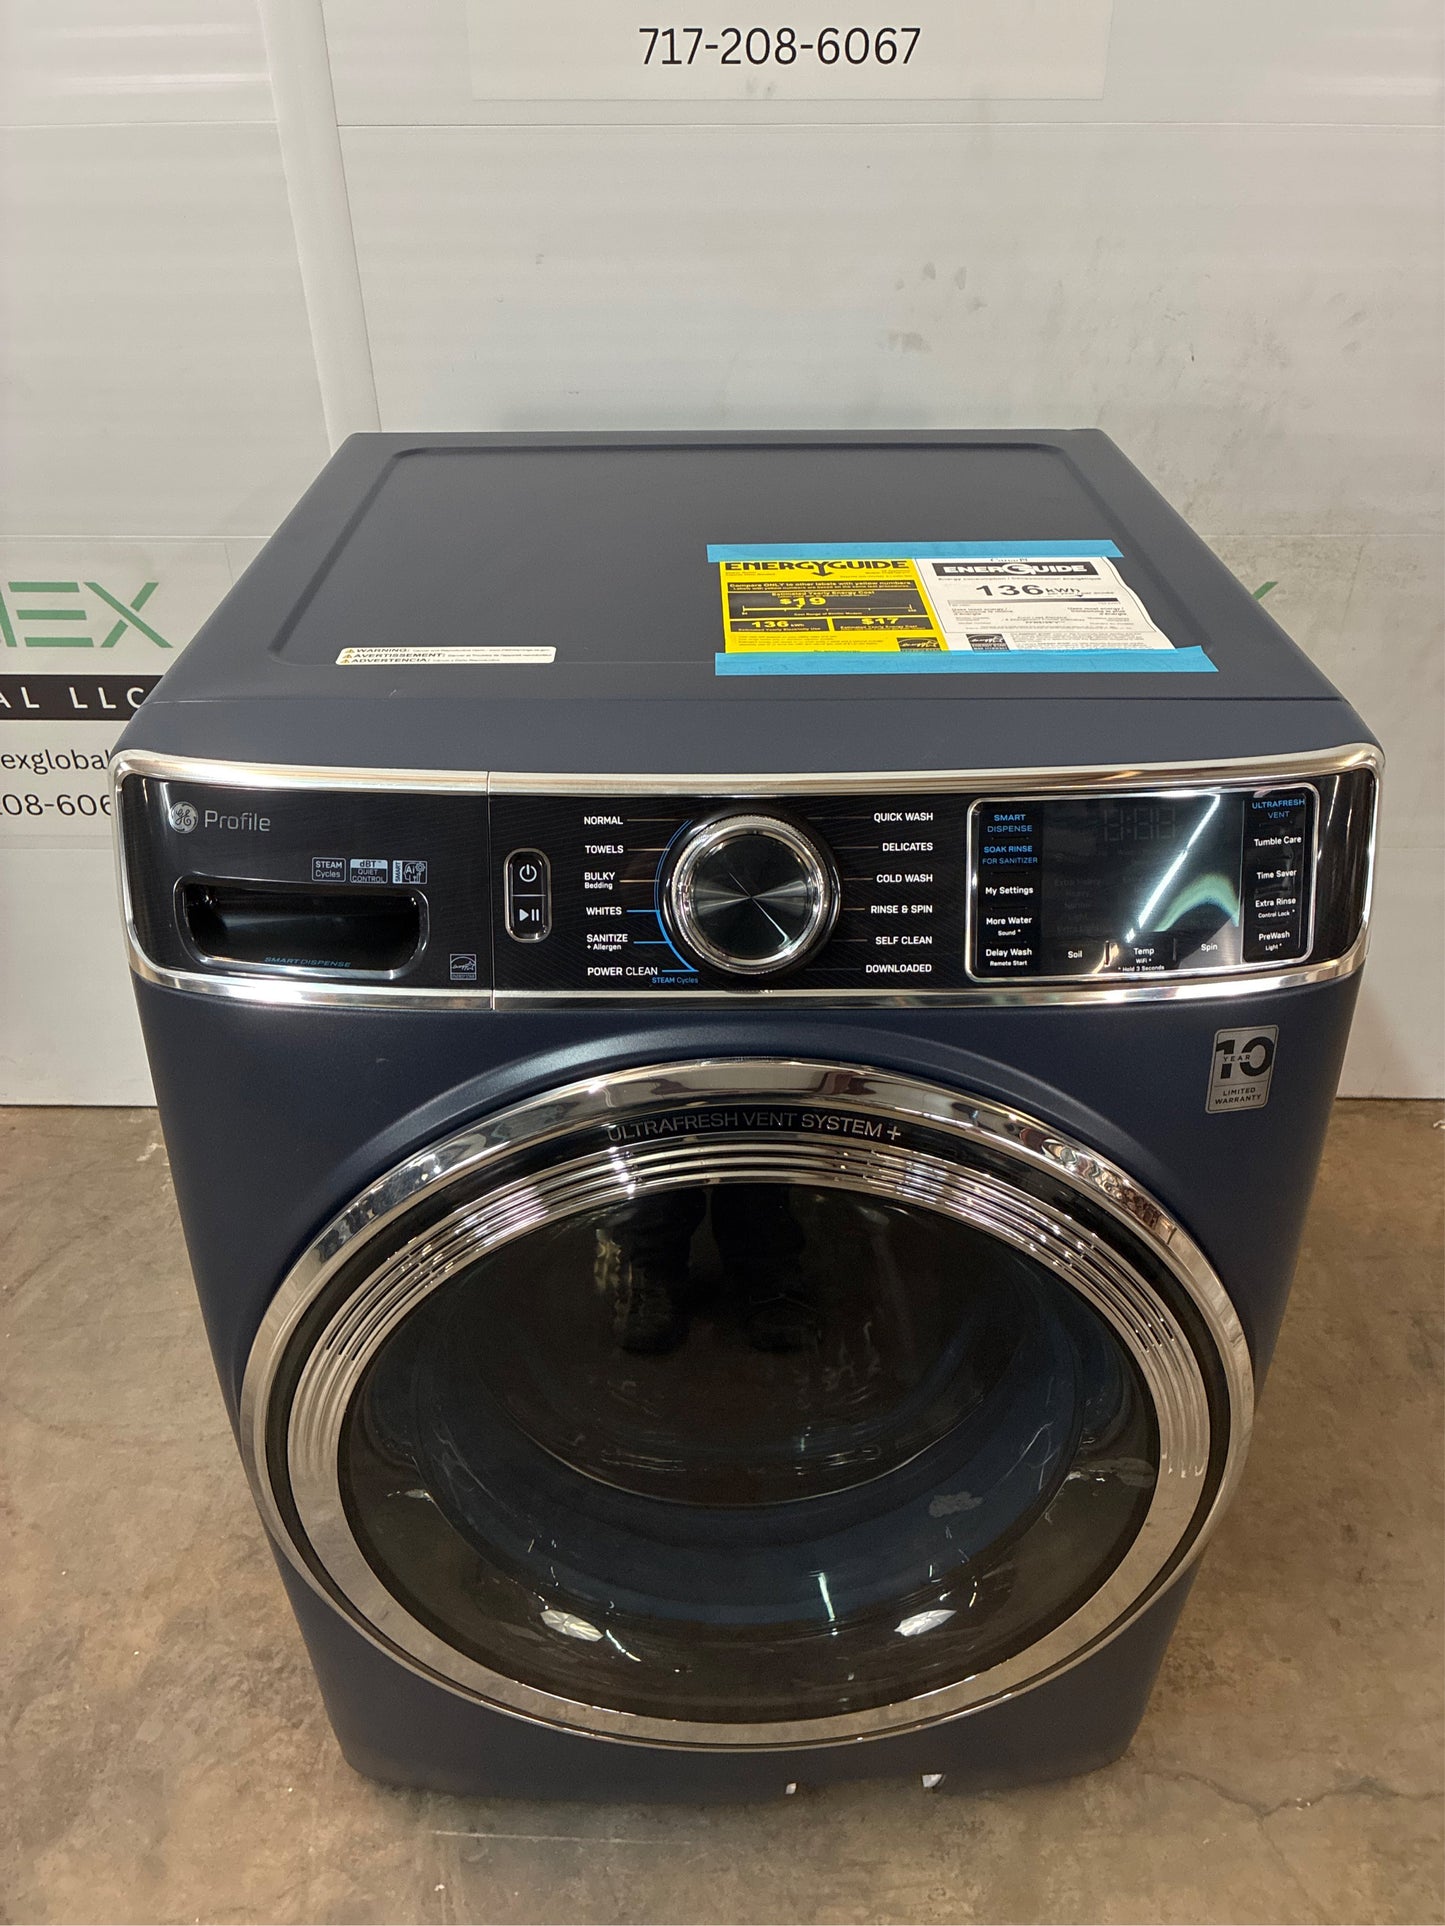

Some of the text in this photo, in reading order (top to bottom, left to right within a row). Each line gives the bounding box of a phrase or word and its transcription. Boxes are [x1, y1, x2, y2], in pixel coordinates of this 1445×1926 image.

[638, 27, 922, 66] 717-208-6067
[724, 560, 910, 575] ENERGYGUIDE
[942, 563, 1088, 575] ENERGUIDE
[976, 584, 1044, 597] 136
[0, 581, 173, 649] EX
[751, 620, 789, 628] 136
[68, 686, 145, 709] LLC
[0, 793, 111, 816] 08-606
[1251, 798, 1306, 810] ULTRAFRESH
[873, 811, 934, 824] QUICK WASH
[993, 814, 1027, 822] SMART
[1267, 810, 1290, 819] VENT
[204, 809, 271, 832] Profile
[583, 815, 624, 825] NORMAL
[986, 824, 1033, 833] DISPENSE
[1253, 835, 1302, 847] Tumble Care
[584, 844, 624, 854] TOWELS
[882, 842, 934, 852] DELICATES
[983, 845, 1033, 854] SOAK RINSE
[315, 861, 343, 869] STEAM
[982, 856, 1038, 865] FOR SANITIZER
[315, 870, 341, 878] Cycles
[357, 868, 379, 876] QUIET
[584, 871, 616, 881] BULKY
[1256, 870, 1297, 880] Time Saver
[352, 875, 385, 883] CONTROL
[876, 873, 933, 883] COLD WASH
[584, 881, 613, 891] Bedding
[985, 885, 1034, 896] My Settings
[1255, 897, 1297, 908] Extra Rinse
[585, 906, 622, 916] WHITES
[870, 904, 933, 914] RINSE & SPIN
[1257, 910, 1277, 919] Control
[985, 916, 1033, 925] More Water
[586, 933, 629, 943] SANITIZE
[875, 935, 933, 945] SELF CLEAN
[1258, 930, 1291, 941] PreWash
[592, 943, 622, 952] Allergen
[985, 947, 1033, 958] Delay Wash
[1133, 947, 1155, 956] Temp
[1200, 943, 1218, 952] Spin
[1265, 944, 1279, 952] Light
[1067, 950, 1083, 959] Soil
[264, 956, 352, 968] SMART DISPENSE
[587, 966, 658, 976] POWER CLEAN
[865, 963, 932, 973] DOWNLOADED
[651, 976, 699, 985] STEAM Cycles
[1215, 1036, 1275, 1080] 10
[1222, 1054, 1251, 1062] YEAR
[1222, 1087, 1256, 1097] LIMITED
[1214, 1094, 1262, 1105] WARRANTY
[607, 1111, 738, 1142] ULTRAFRESH
[742, 1111, 798, 1127] VENT
[800, 1113, 883, 1137] SYSTEM
